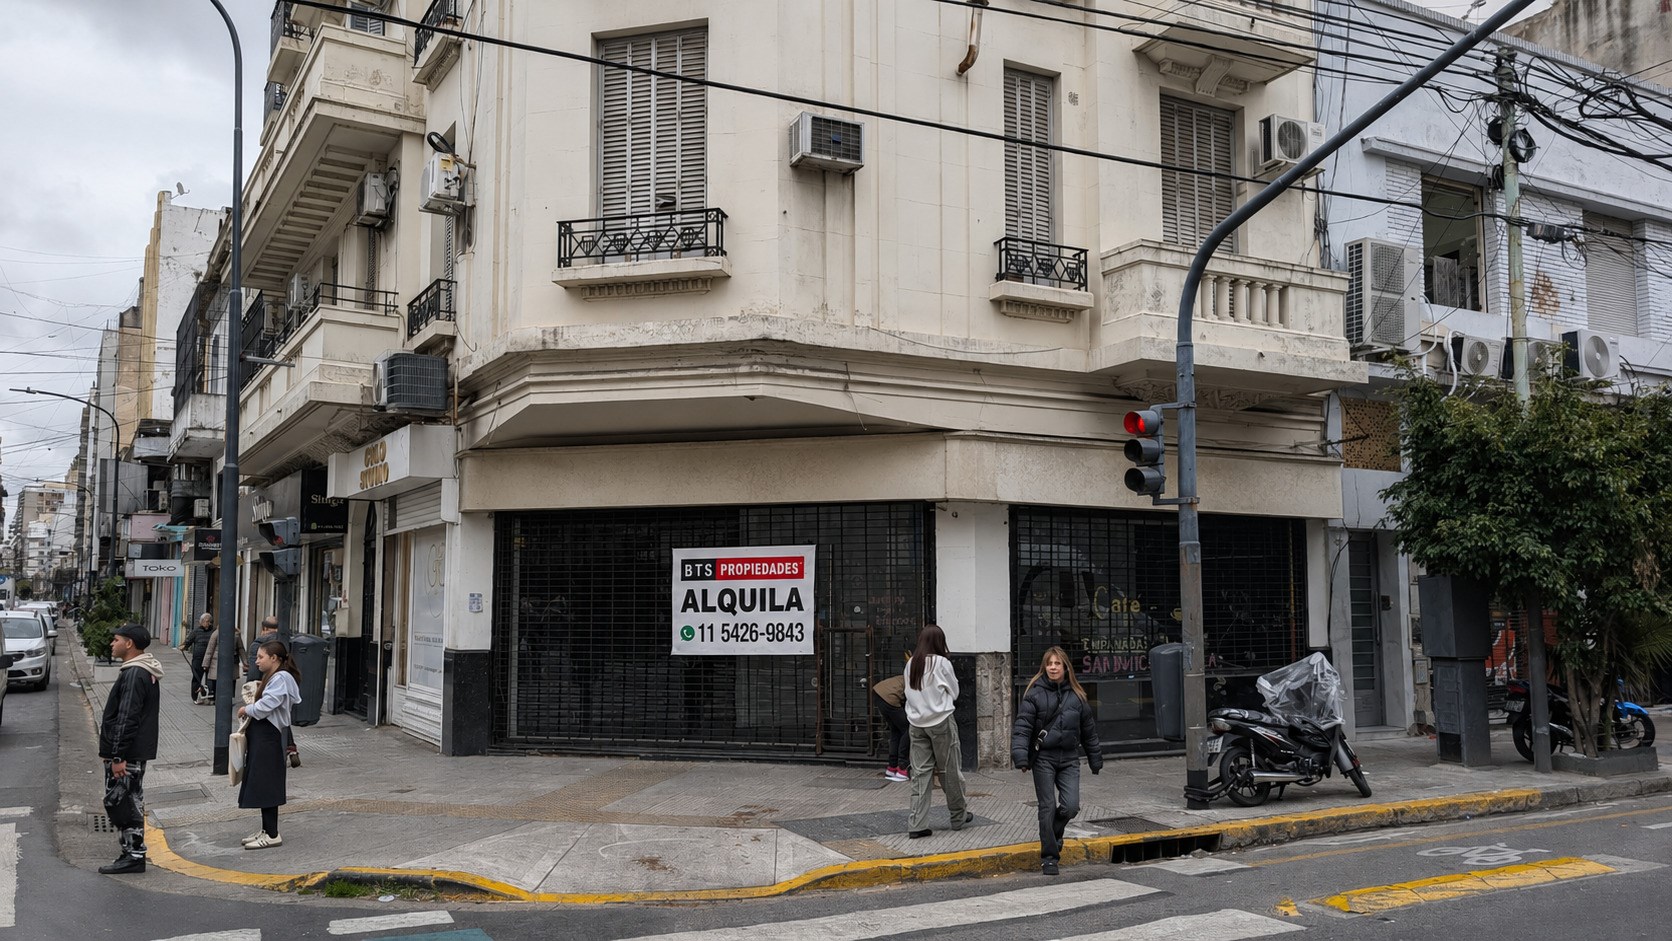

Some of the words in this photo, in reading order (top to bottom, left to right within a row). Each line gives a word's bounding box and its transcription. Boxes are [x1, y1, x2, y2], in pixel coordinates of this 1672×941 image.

[684, 563, 713, 577] BTS
[720, 562, 799, 576] PROPIEDADES
[680, 587, 805, 616] ALQUILA
[698, 623, 714, 642] 11
[721, 622, 805, 642] 5426-9843
[1081, 655, 1150, 674] SANDWIC
